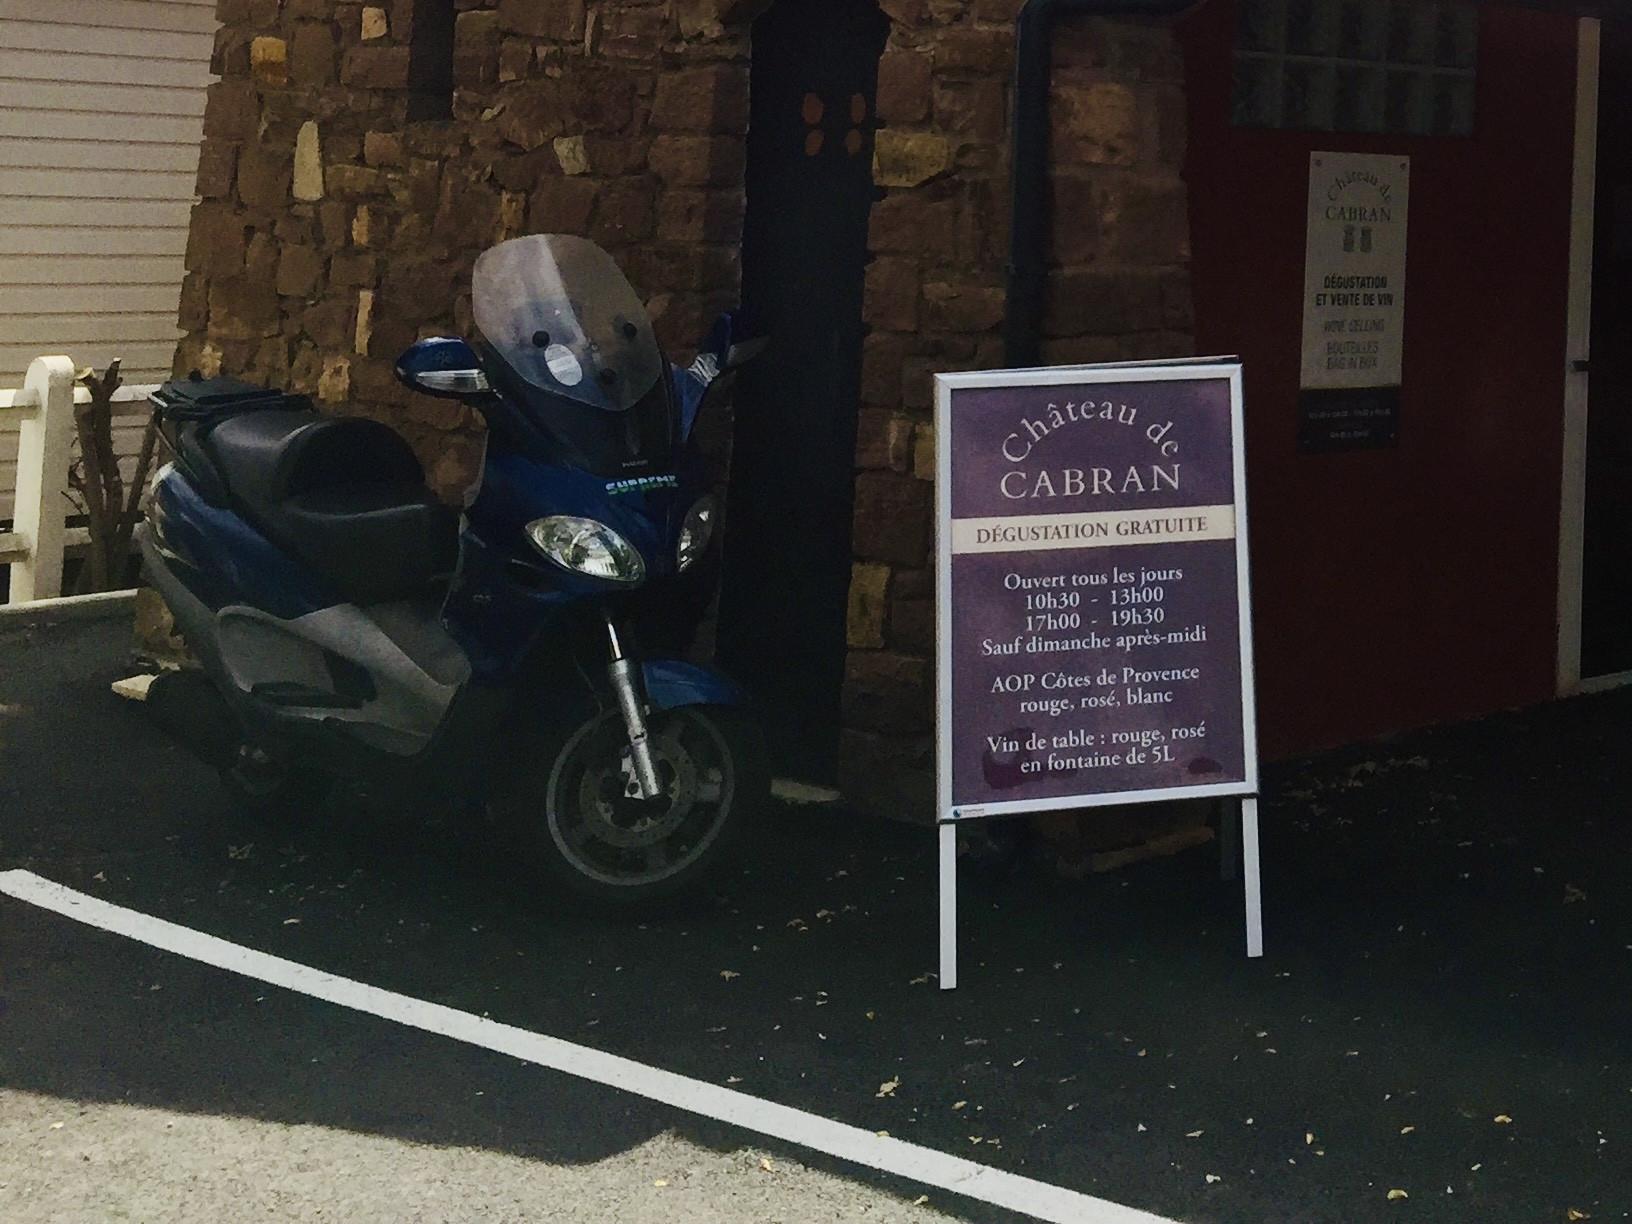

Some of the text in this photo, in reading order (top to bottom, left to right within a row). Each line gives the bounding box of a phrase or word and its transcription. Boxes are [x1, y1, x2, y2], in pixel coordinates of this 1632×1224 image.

[1327, 168, 1378, 202] Château
[1325, 206, 1391, 222] CABRAN
[1324, 273, 1387, 289] DÉGUSTATION
[1316, 293, 1393, 307] ET VENTE DE VIN
[1002, 401, 1179, 463] Château de
[1000, 464, 1181, 499] CABRAN
[976, 516, 1208, 544] DÉGUSTATION GRATUITE
[1004, 567, 1183, 590] Ouvert tous les jours
[1026, 591, 1080, 610] 10h30
[1111, 587, 1164, 605] 13h00
[1026, 612, 1080, 631] 17h00
[1111, 607, 1165, 626] 19h30
[982, 625, 1207, 656] Sauf dimanche après-midi
[991, 667, 1200, 693] AOP Côtes de Provence
[1020, 689, 1173, 716] rouge, rosé, blanc
[986, 735, 1019, 753] Vin
[1026, 732, 1047, 751] de
[1052, 728, 1095, 749] table
[1112, 729, 1166, 746] rouge,
[1171, 721, 1206, 740] rosé
[1021, 744, 1175, 773] en fontaine de 5L
